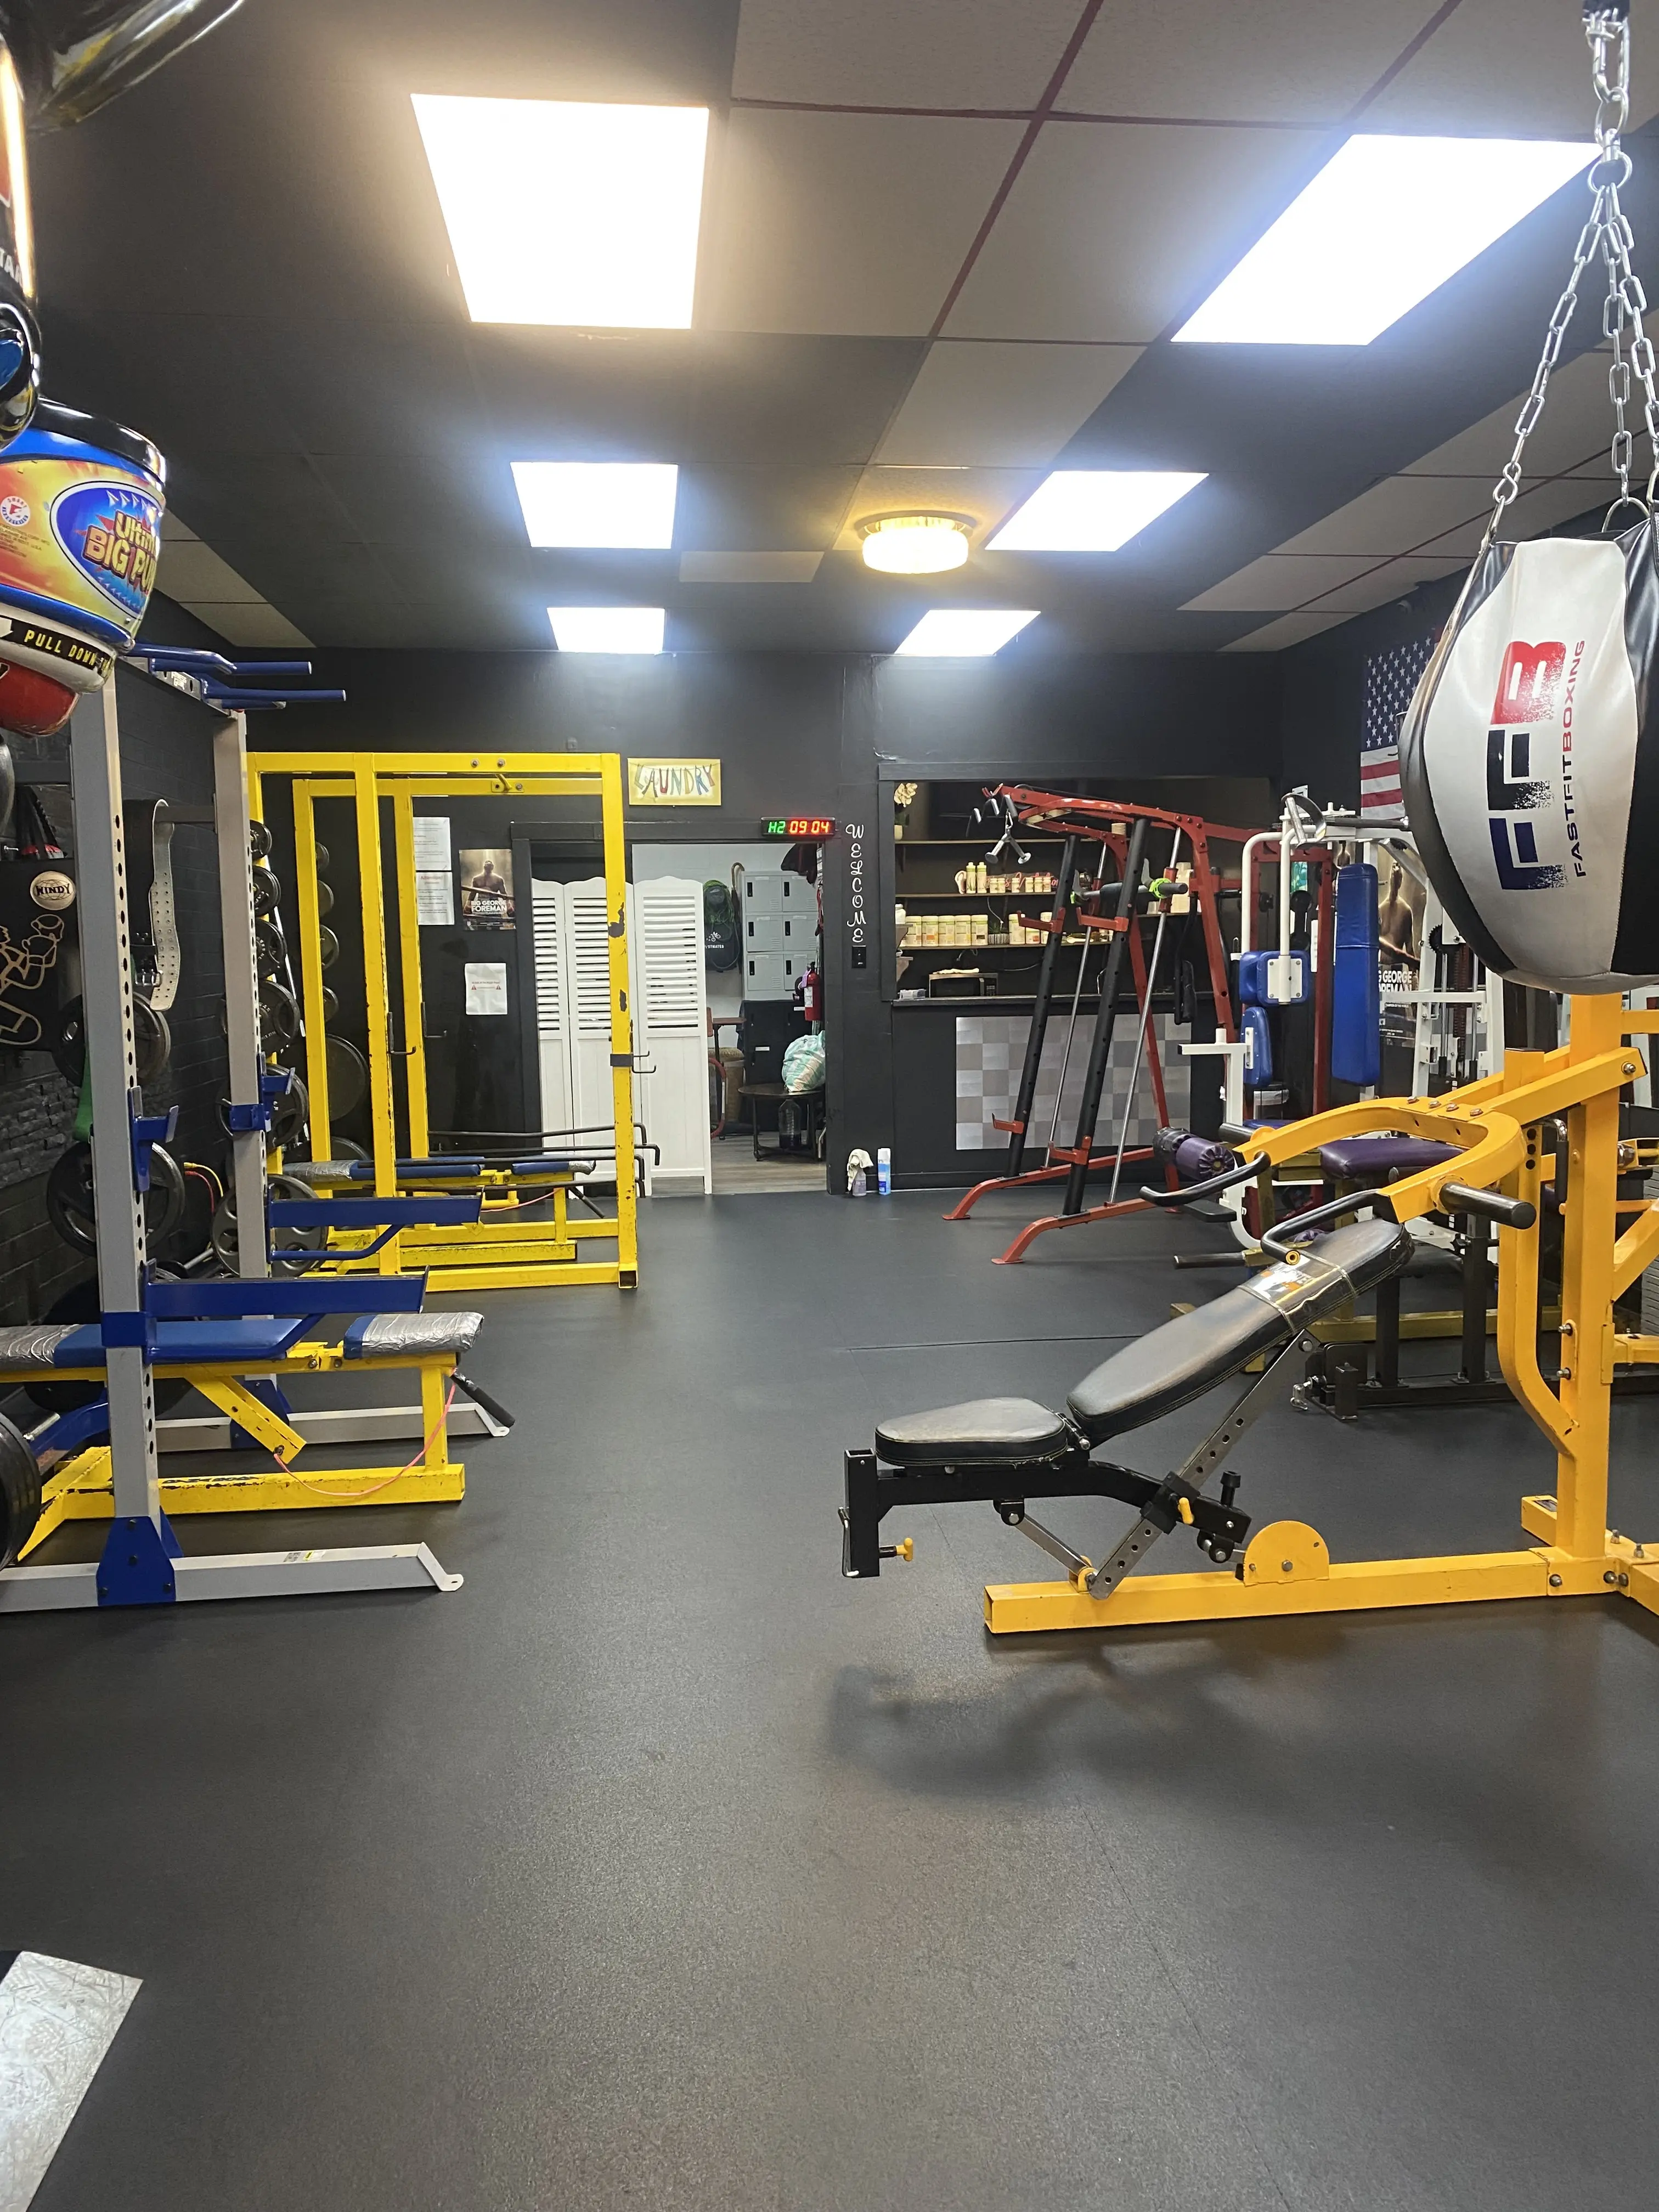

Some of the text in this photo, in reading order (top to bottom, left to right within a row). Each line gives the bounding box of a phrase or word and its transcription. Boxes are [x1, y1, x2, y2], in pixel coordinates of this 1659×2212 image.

[83, 525, 131, 579] BIG
[24, 629, 61, 653] PULL
[68, 644, 97, 666] DOWN
[1562, 640, 1587, 878] FASTFITBOXING
[634, 764, 716, 798] LAUNDRY
[36, 883, 70, 896] WINDY
[845, 823, 867, 943] WELCOME
[1383, 970, 1413, 983] GEORGE
